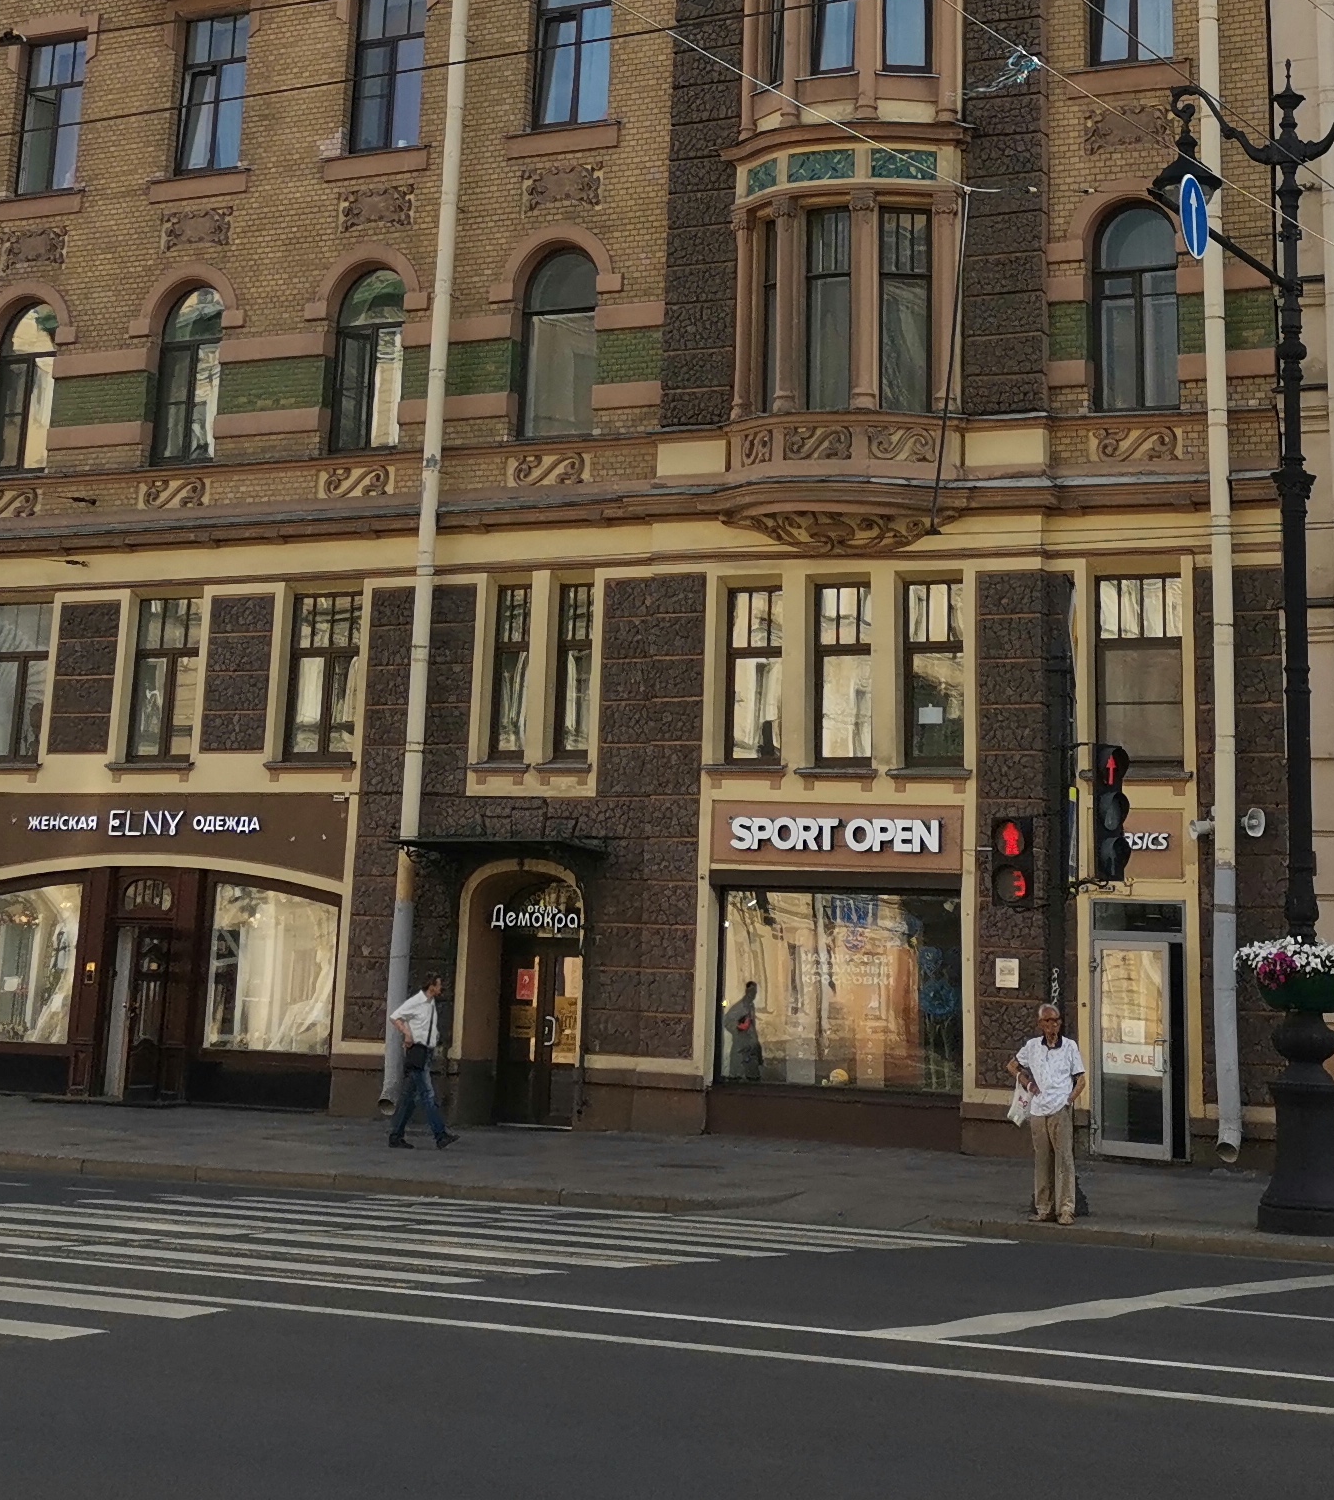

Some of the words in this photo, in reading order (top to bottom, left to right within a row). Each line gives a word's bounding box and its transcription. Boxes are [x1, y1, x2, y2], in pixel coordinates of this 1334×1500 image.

[28, 815, 98, 831] ЖЕНСКАЯ
[108, 810, 184, 836] ELNY
[192, 815, 261, 833] ОДЕЖДА
[730, 816, 840, 851] SPORT
[845, 818, 940, 853] OPEN
[527, 905, 559, 914] отель
[1124, 1054, 1154, 1066] SALE
